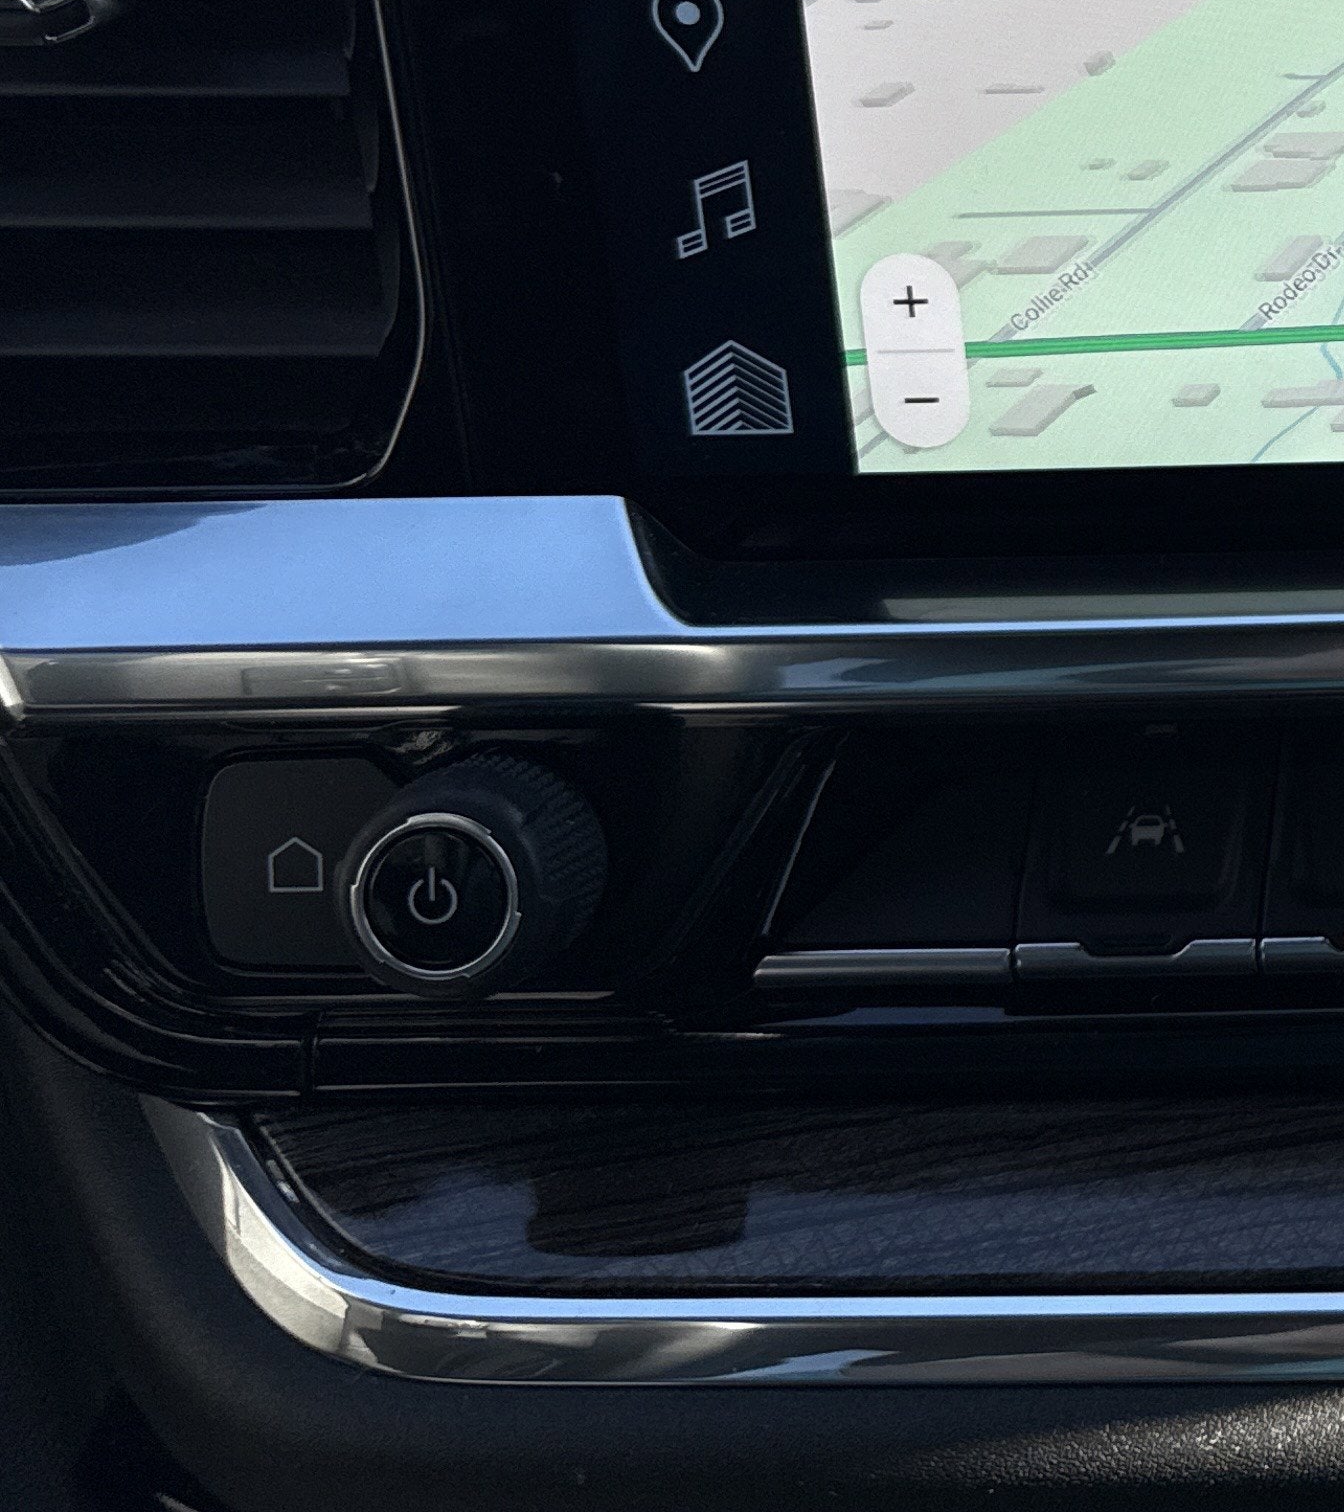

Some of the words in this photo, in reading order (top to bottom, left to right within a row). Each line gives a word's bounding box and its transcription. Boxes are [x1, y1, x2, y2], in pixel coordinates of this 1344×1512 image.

[1008, 280, 1064, 335] Collie
[1052, 261, 1092, 297] Rd
[1257, 268, 1318, 323] Rodeo
